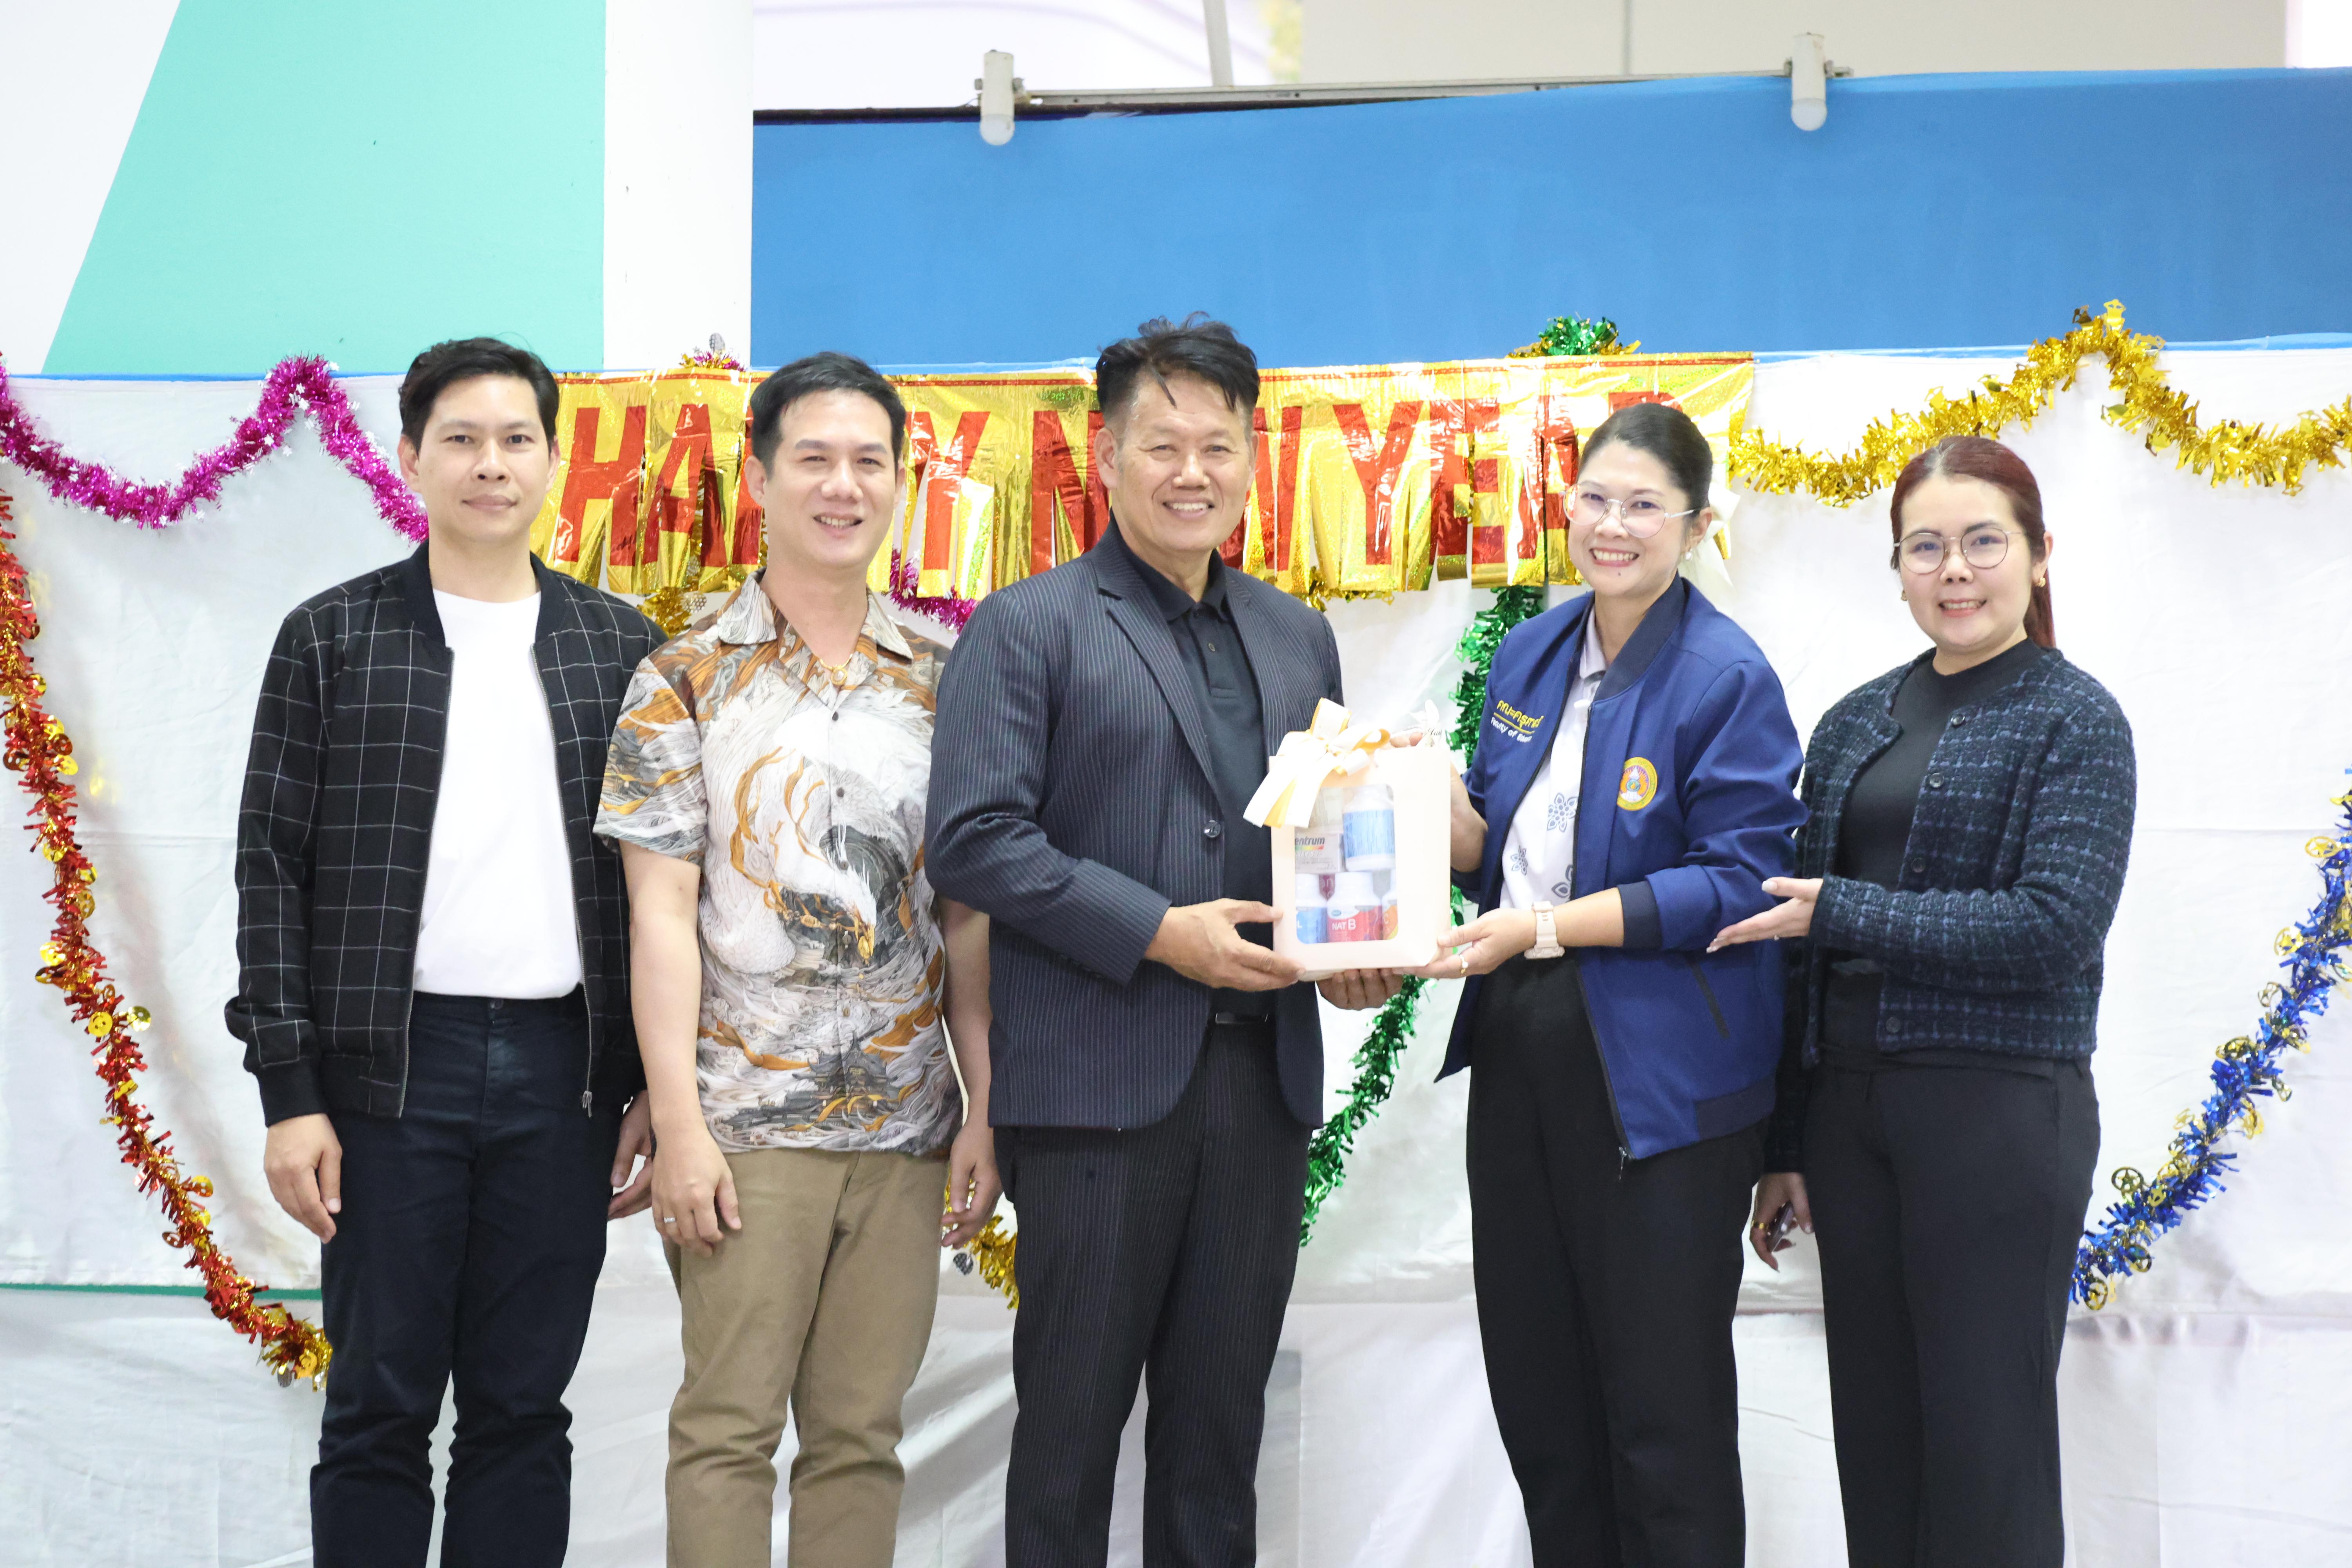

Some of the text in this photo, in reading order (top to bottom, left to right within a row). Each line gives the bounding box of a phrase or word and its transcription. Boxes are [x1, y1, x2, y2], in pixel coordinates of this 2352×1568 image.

[553, 391, 1684, 576] HAY NW YEA
[1491, 717, 1509, 734] Faculty
[1508, 730, 1519, 738] of
[1295, 836, 1325, 845] entrum
[1332, 922, 1347, 931] NAT
[1348, 918, 1356, 931] B
